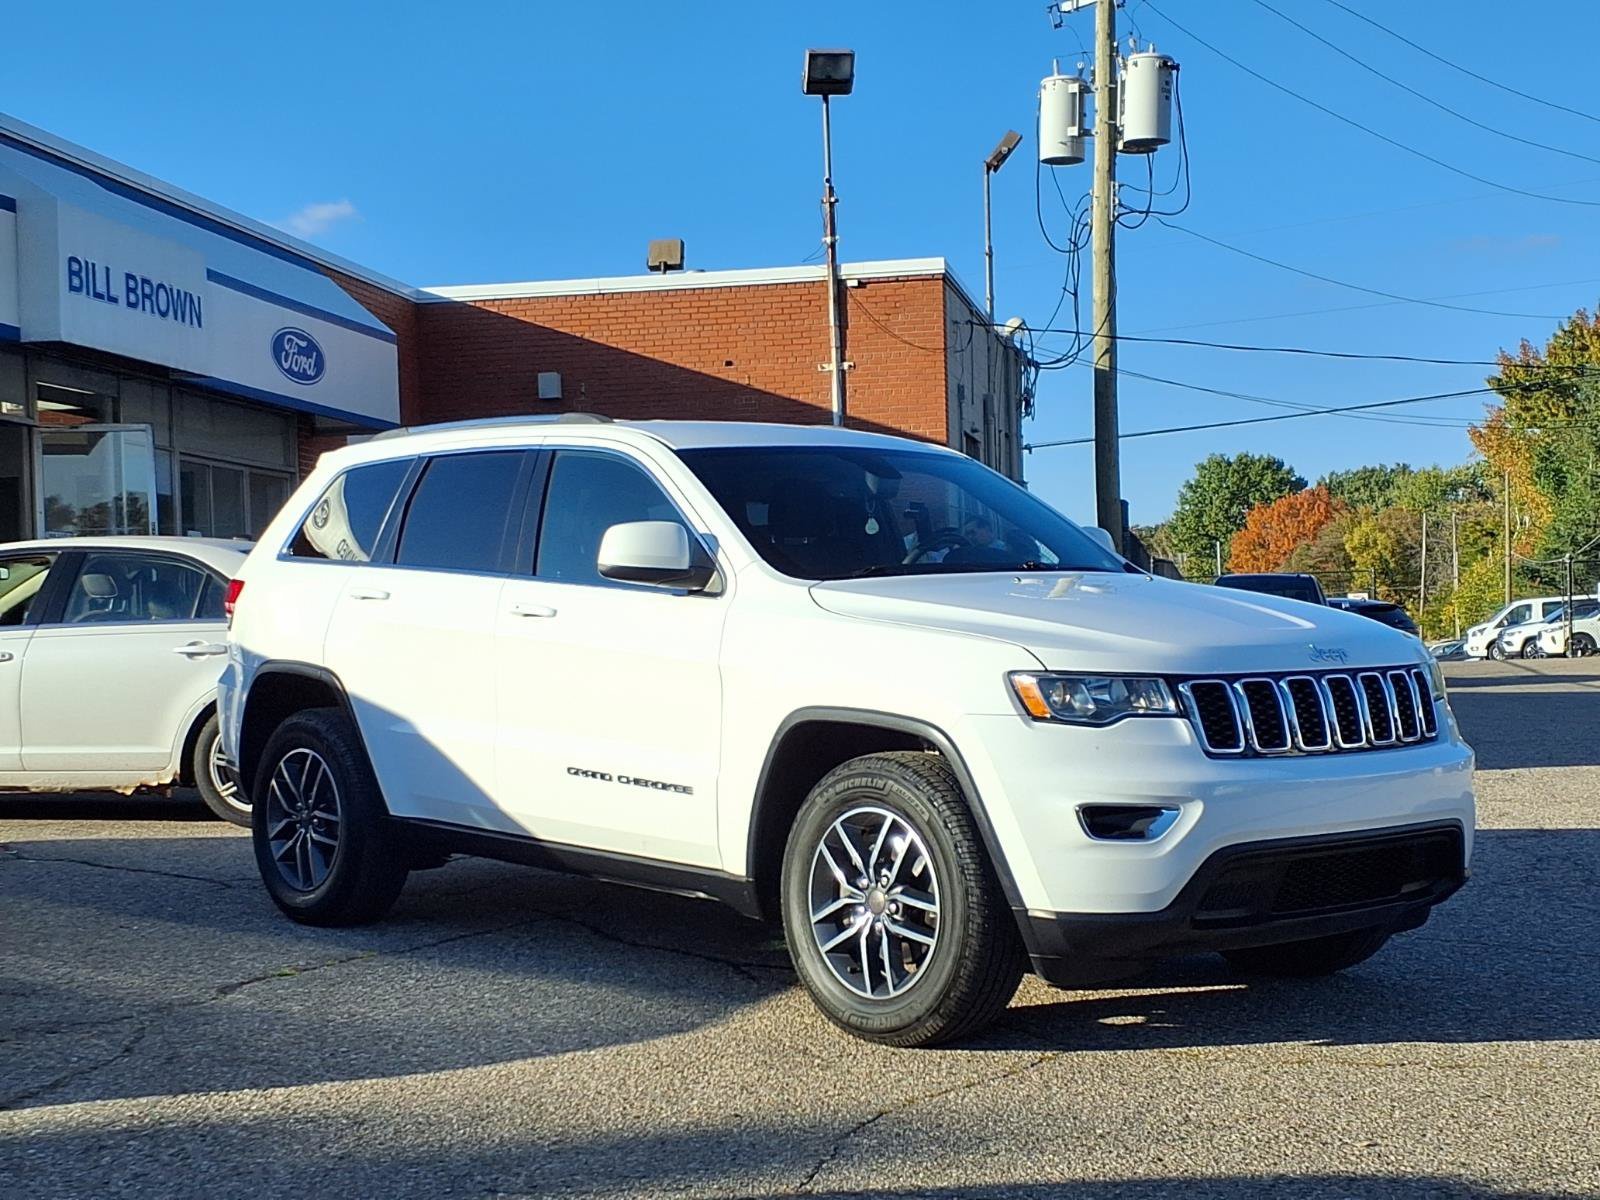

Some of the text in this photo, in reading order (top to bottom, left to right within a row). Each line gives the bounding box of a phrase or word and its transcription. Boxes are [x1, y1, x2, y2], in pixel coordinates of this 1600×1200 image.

[68, 256, 202, 328] BILL BROWN
[281, 334, 317, 377] Ford
[1307, 642, 1347, 665] Jeep
[567, 766, 694, 795] GRAND CHEROKEE
[835, 777, 886, 793] MICHELIN
